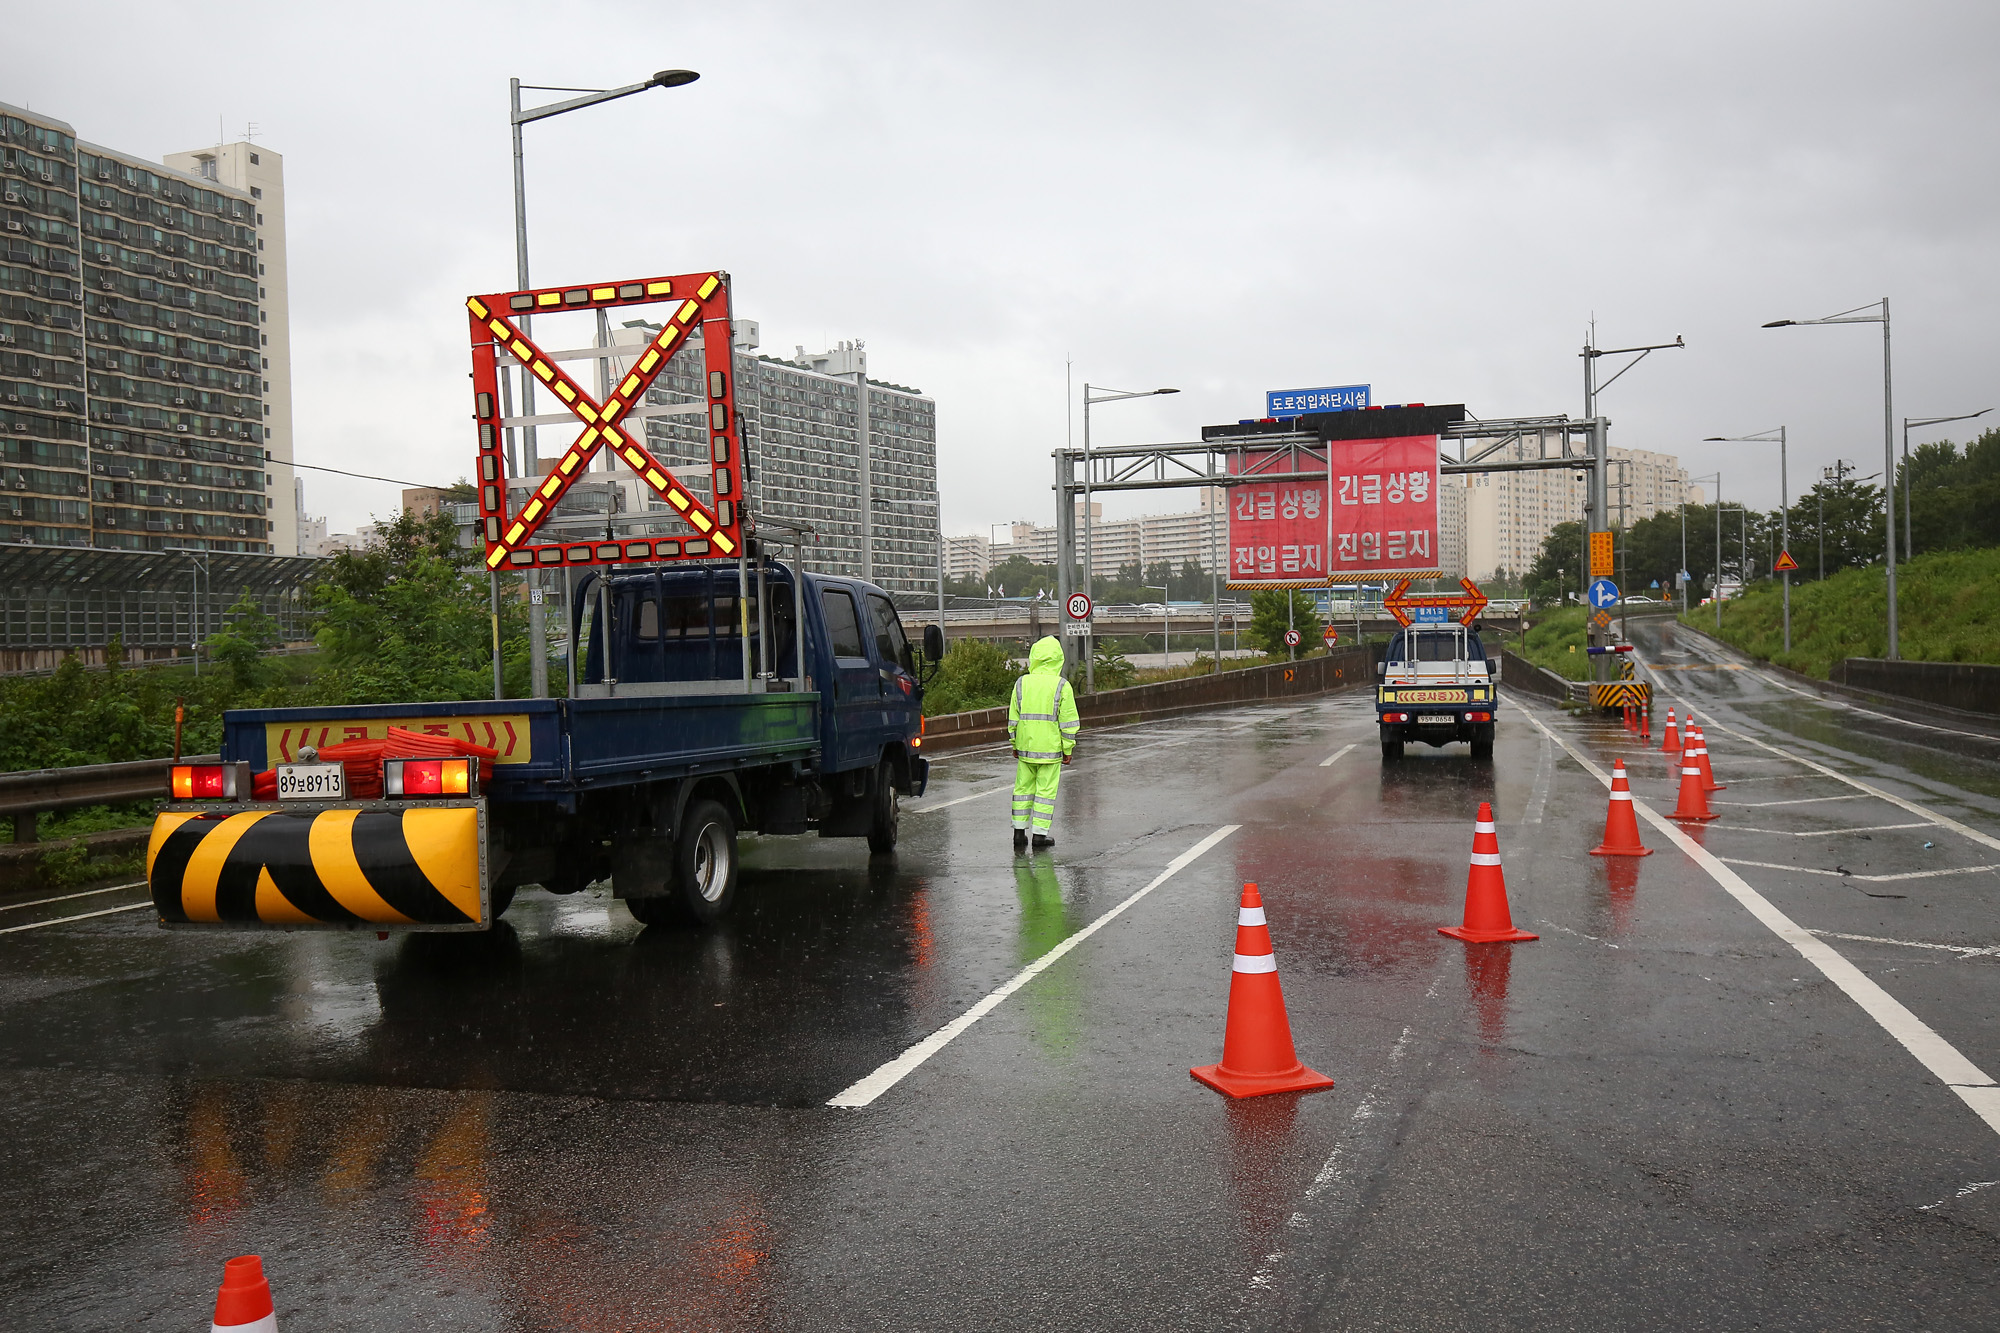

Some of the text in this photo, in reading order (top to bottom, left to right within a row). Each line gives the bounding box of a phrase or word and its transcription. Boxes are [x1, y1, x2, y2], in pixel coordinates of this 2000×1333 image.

[1272, 390, 1367, 411] 도로진입차단시설
[1072, 600, 1086, 612] 80
[1417, 691, 1447, 701] 공사중
[280, 774, 340, 793] 89보8913
